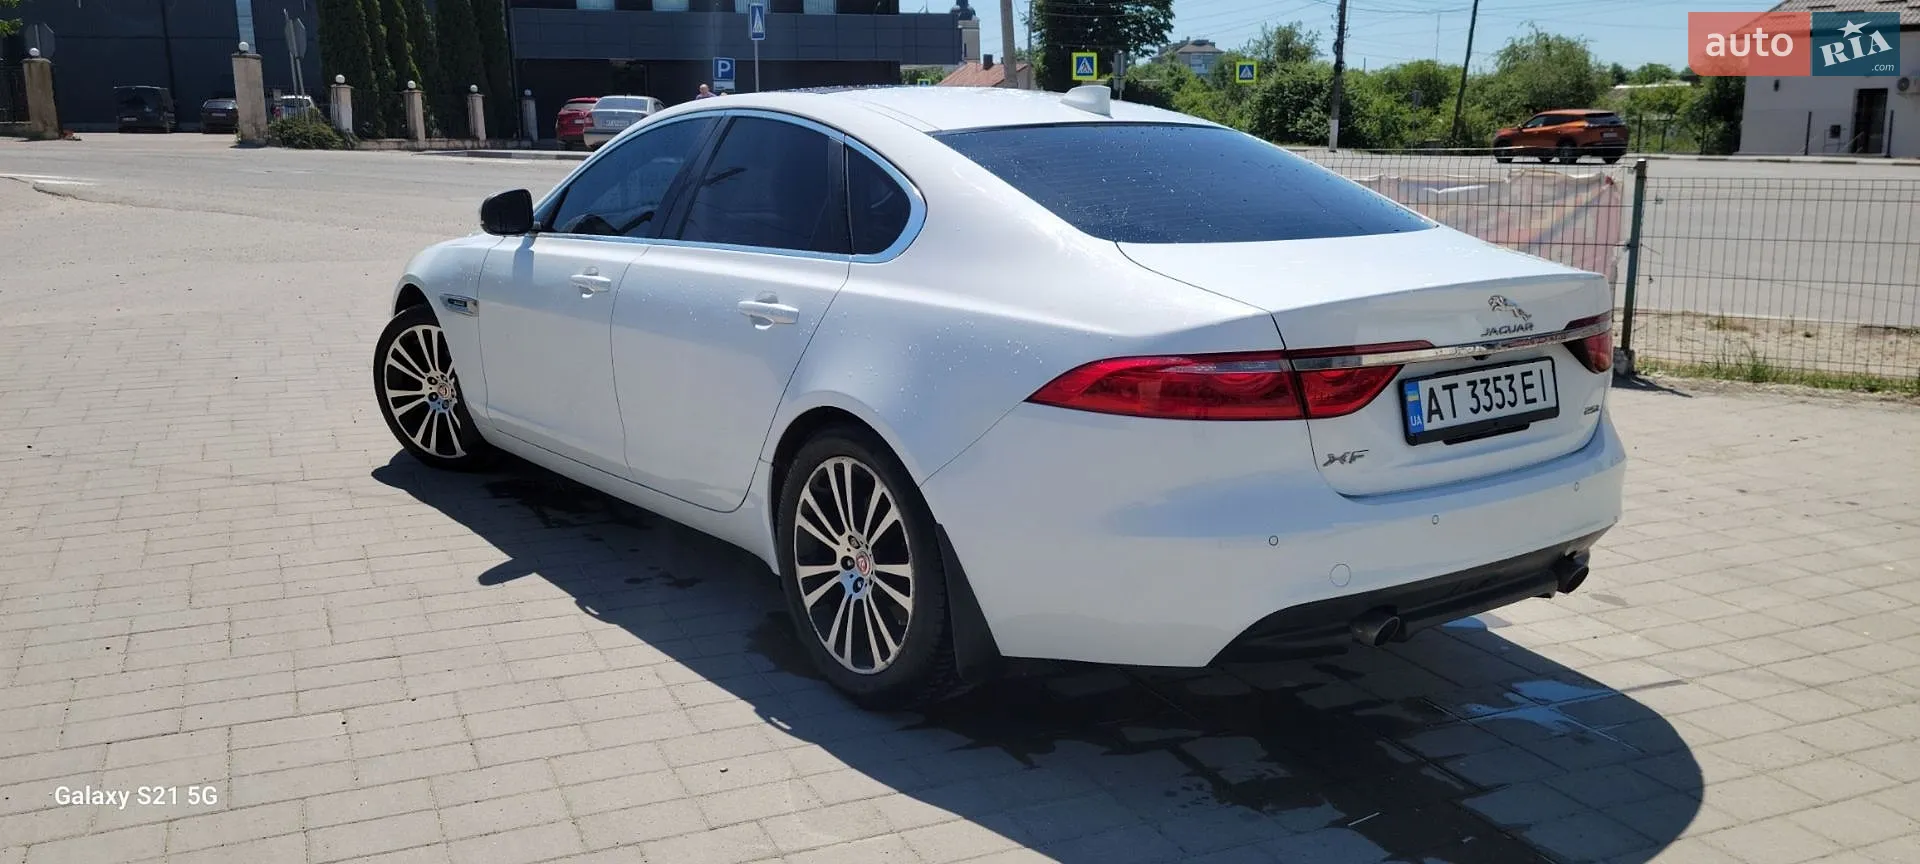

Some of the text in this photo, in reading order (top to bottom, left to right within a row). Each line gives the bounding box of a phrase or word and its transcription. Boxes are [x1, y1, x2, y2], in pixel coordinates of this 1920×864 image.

[717, 60, 731, 78] P
[1480, 322, 1534, 337] JAGUAR
[1426, 368, 1547, 423] AT 3353 EI
[1410, 415, 1423, 427] UA
[1322, 449, 1369, 467] XF
